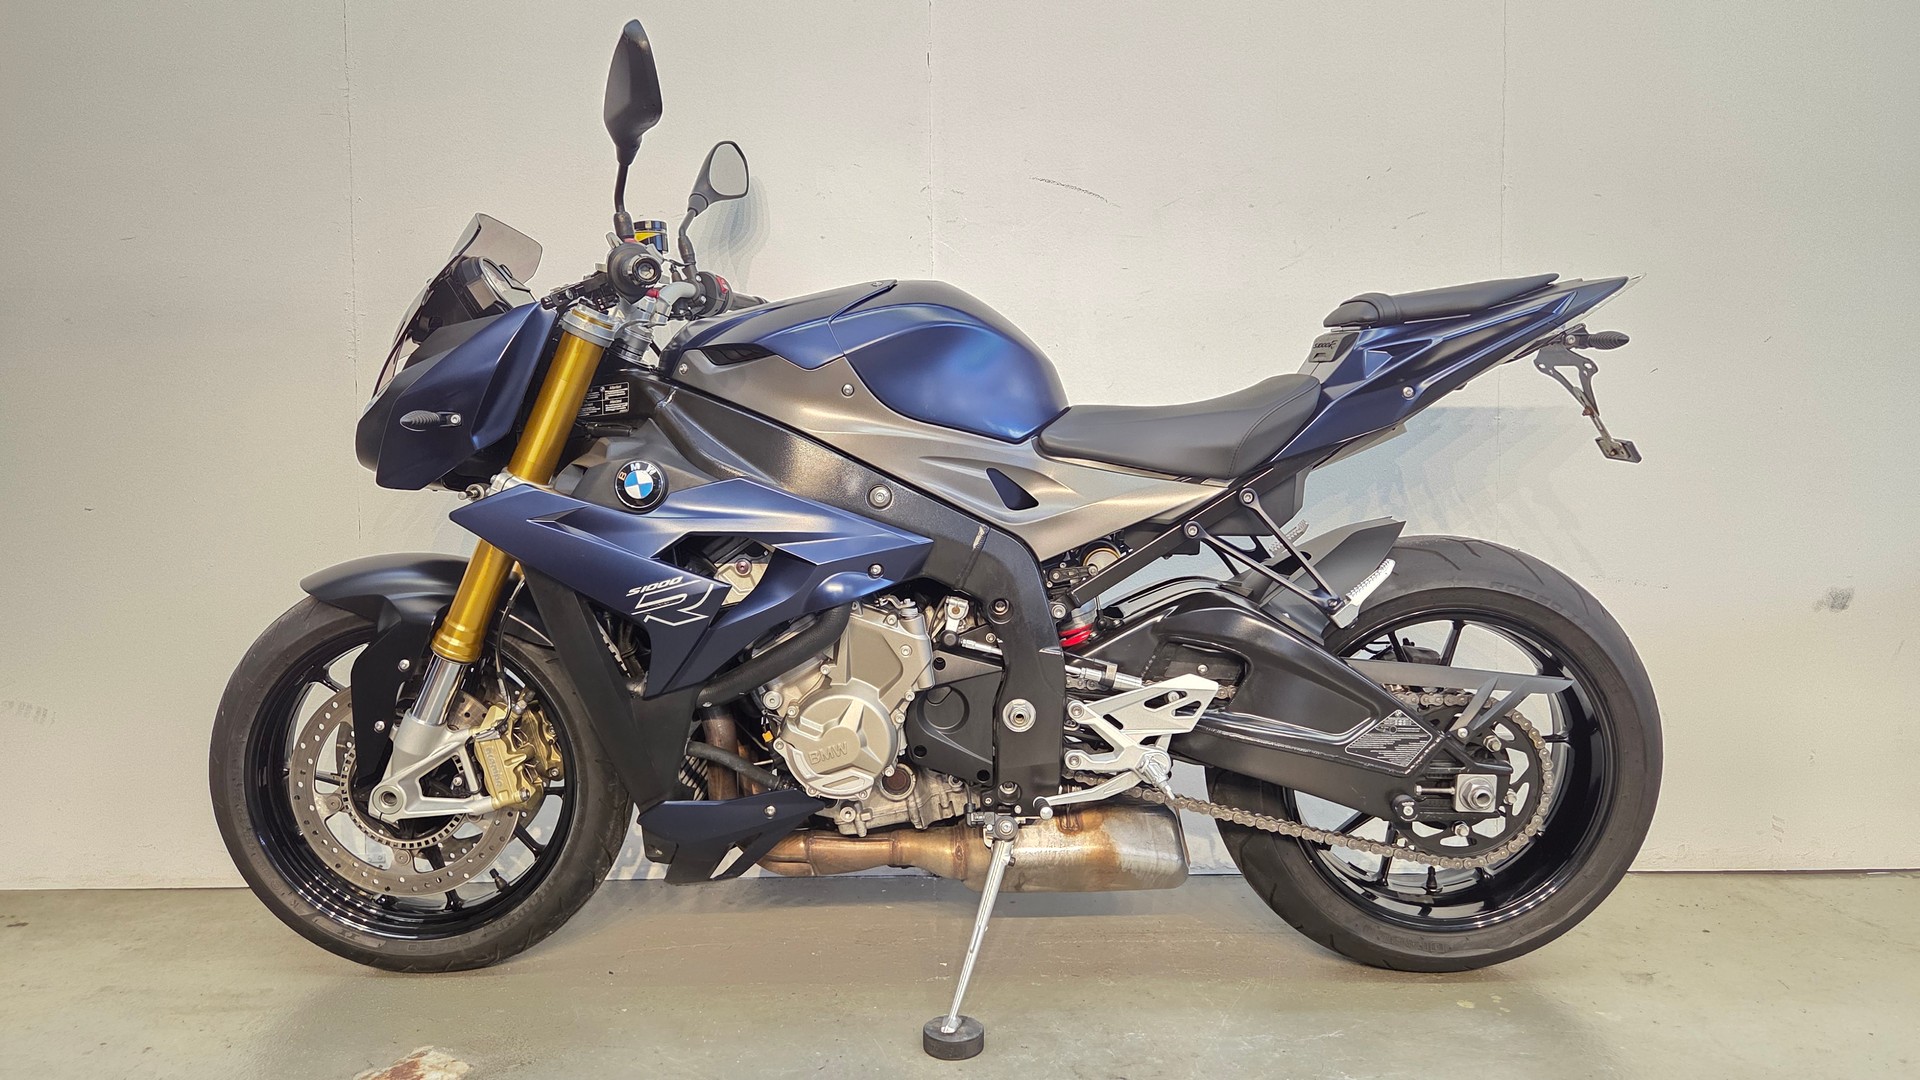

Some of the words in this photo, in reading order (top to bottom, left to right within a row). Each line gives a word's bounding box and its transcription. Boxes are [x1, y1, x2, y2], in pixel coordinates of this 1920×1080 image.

[618, 462, 657, 481] BMW
[626, 576, 684, 597] S1000
[631, 579, 714, 627] R
[808, 741, 848, 766] BMW
